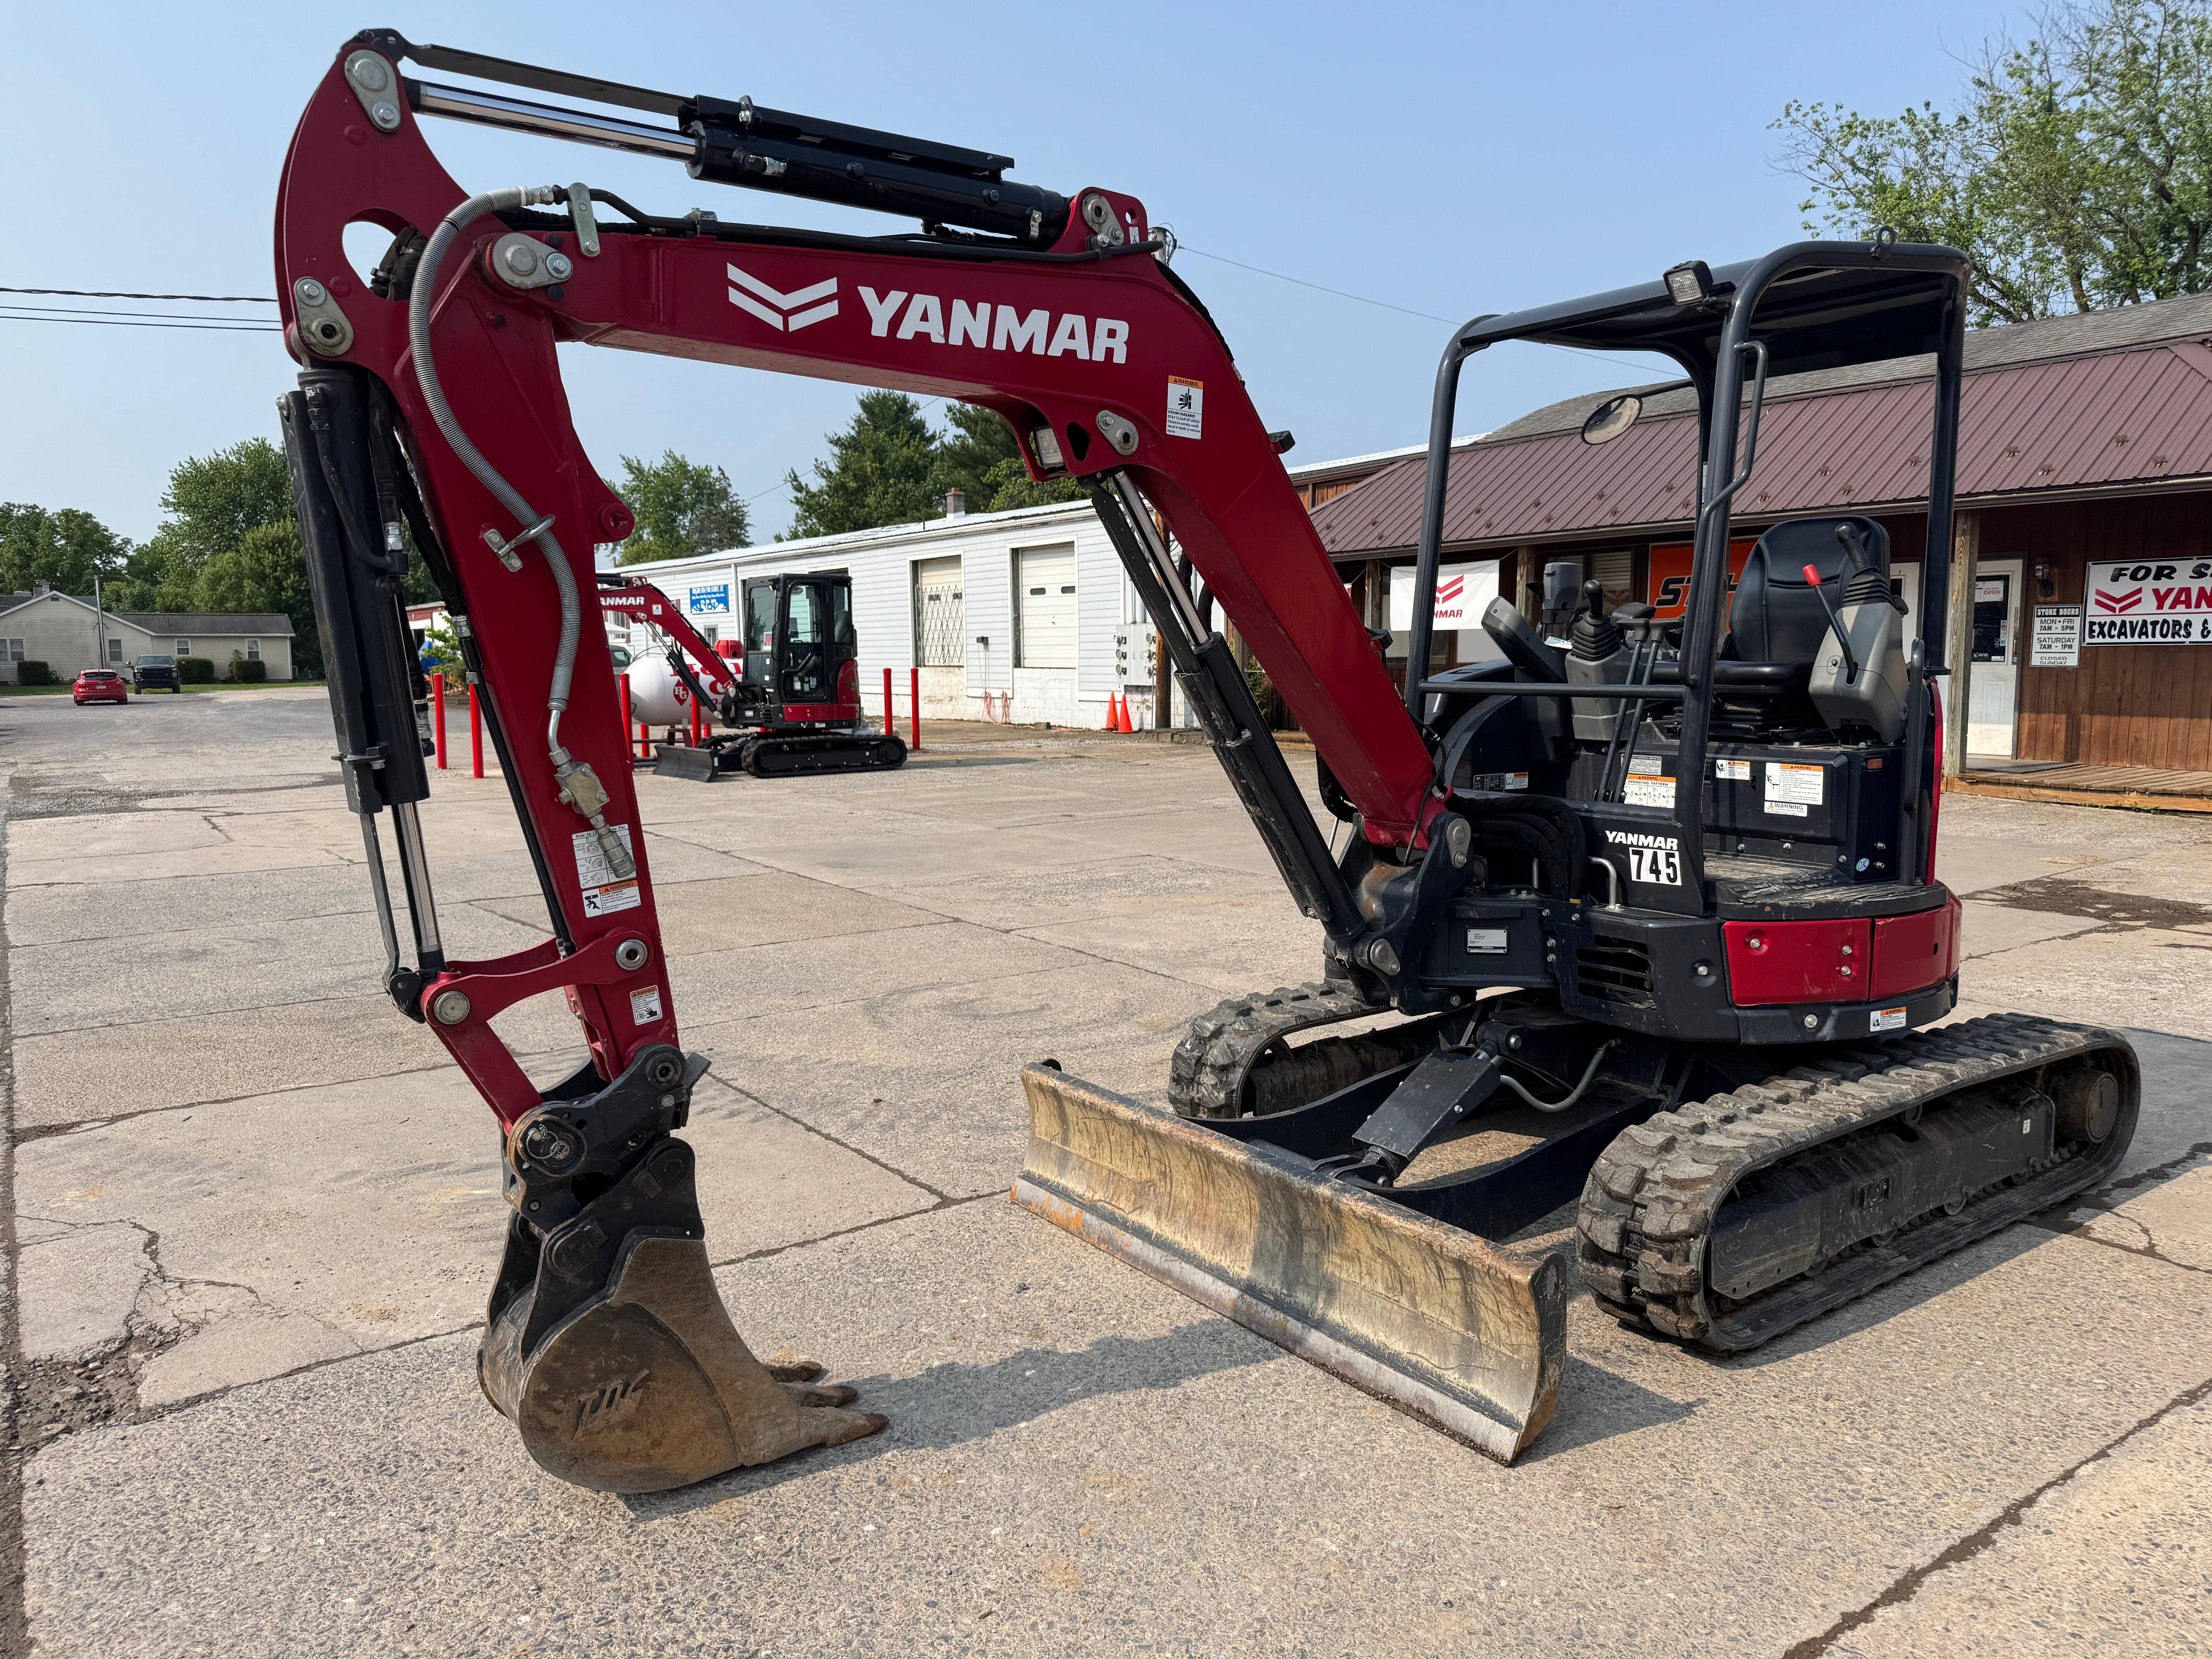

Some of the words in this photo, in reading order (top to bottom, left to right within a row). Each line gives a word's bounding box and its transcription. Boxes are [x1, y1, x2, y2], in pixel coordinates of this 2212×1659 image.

[858, 285, 1129, 364] YANMAR
[1178, 378, 1198, 387] WARNING
[2110, 565, 2177, 582] FOR
[600, 596, 644, 606] ANMAR
[1434, 610, 1463, 618] NMAR
[2088, 618, 2192, 639] EXCAVATORS
[2200, 618, 2211, 639] &
[1605, 830, 1678, 850] YANMAR
[1632, 849, 1678, 883] 745
[1858, 859, 1867, 870] OK
[610, 882, 633, 890] WARNING
